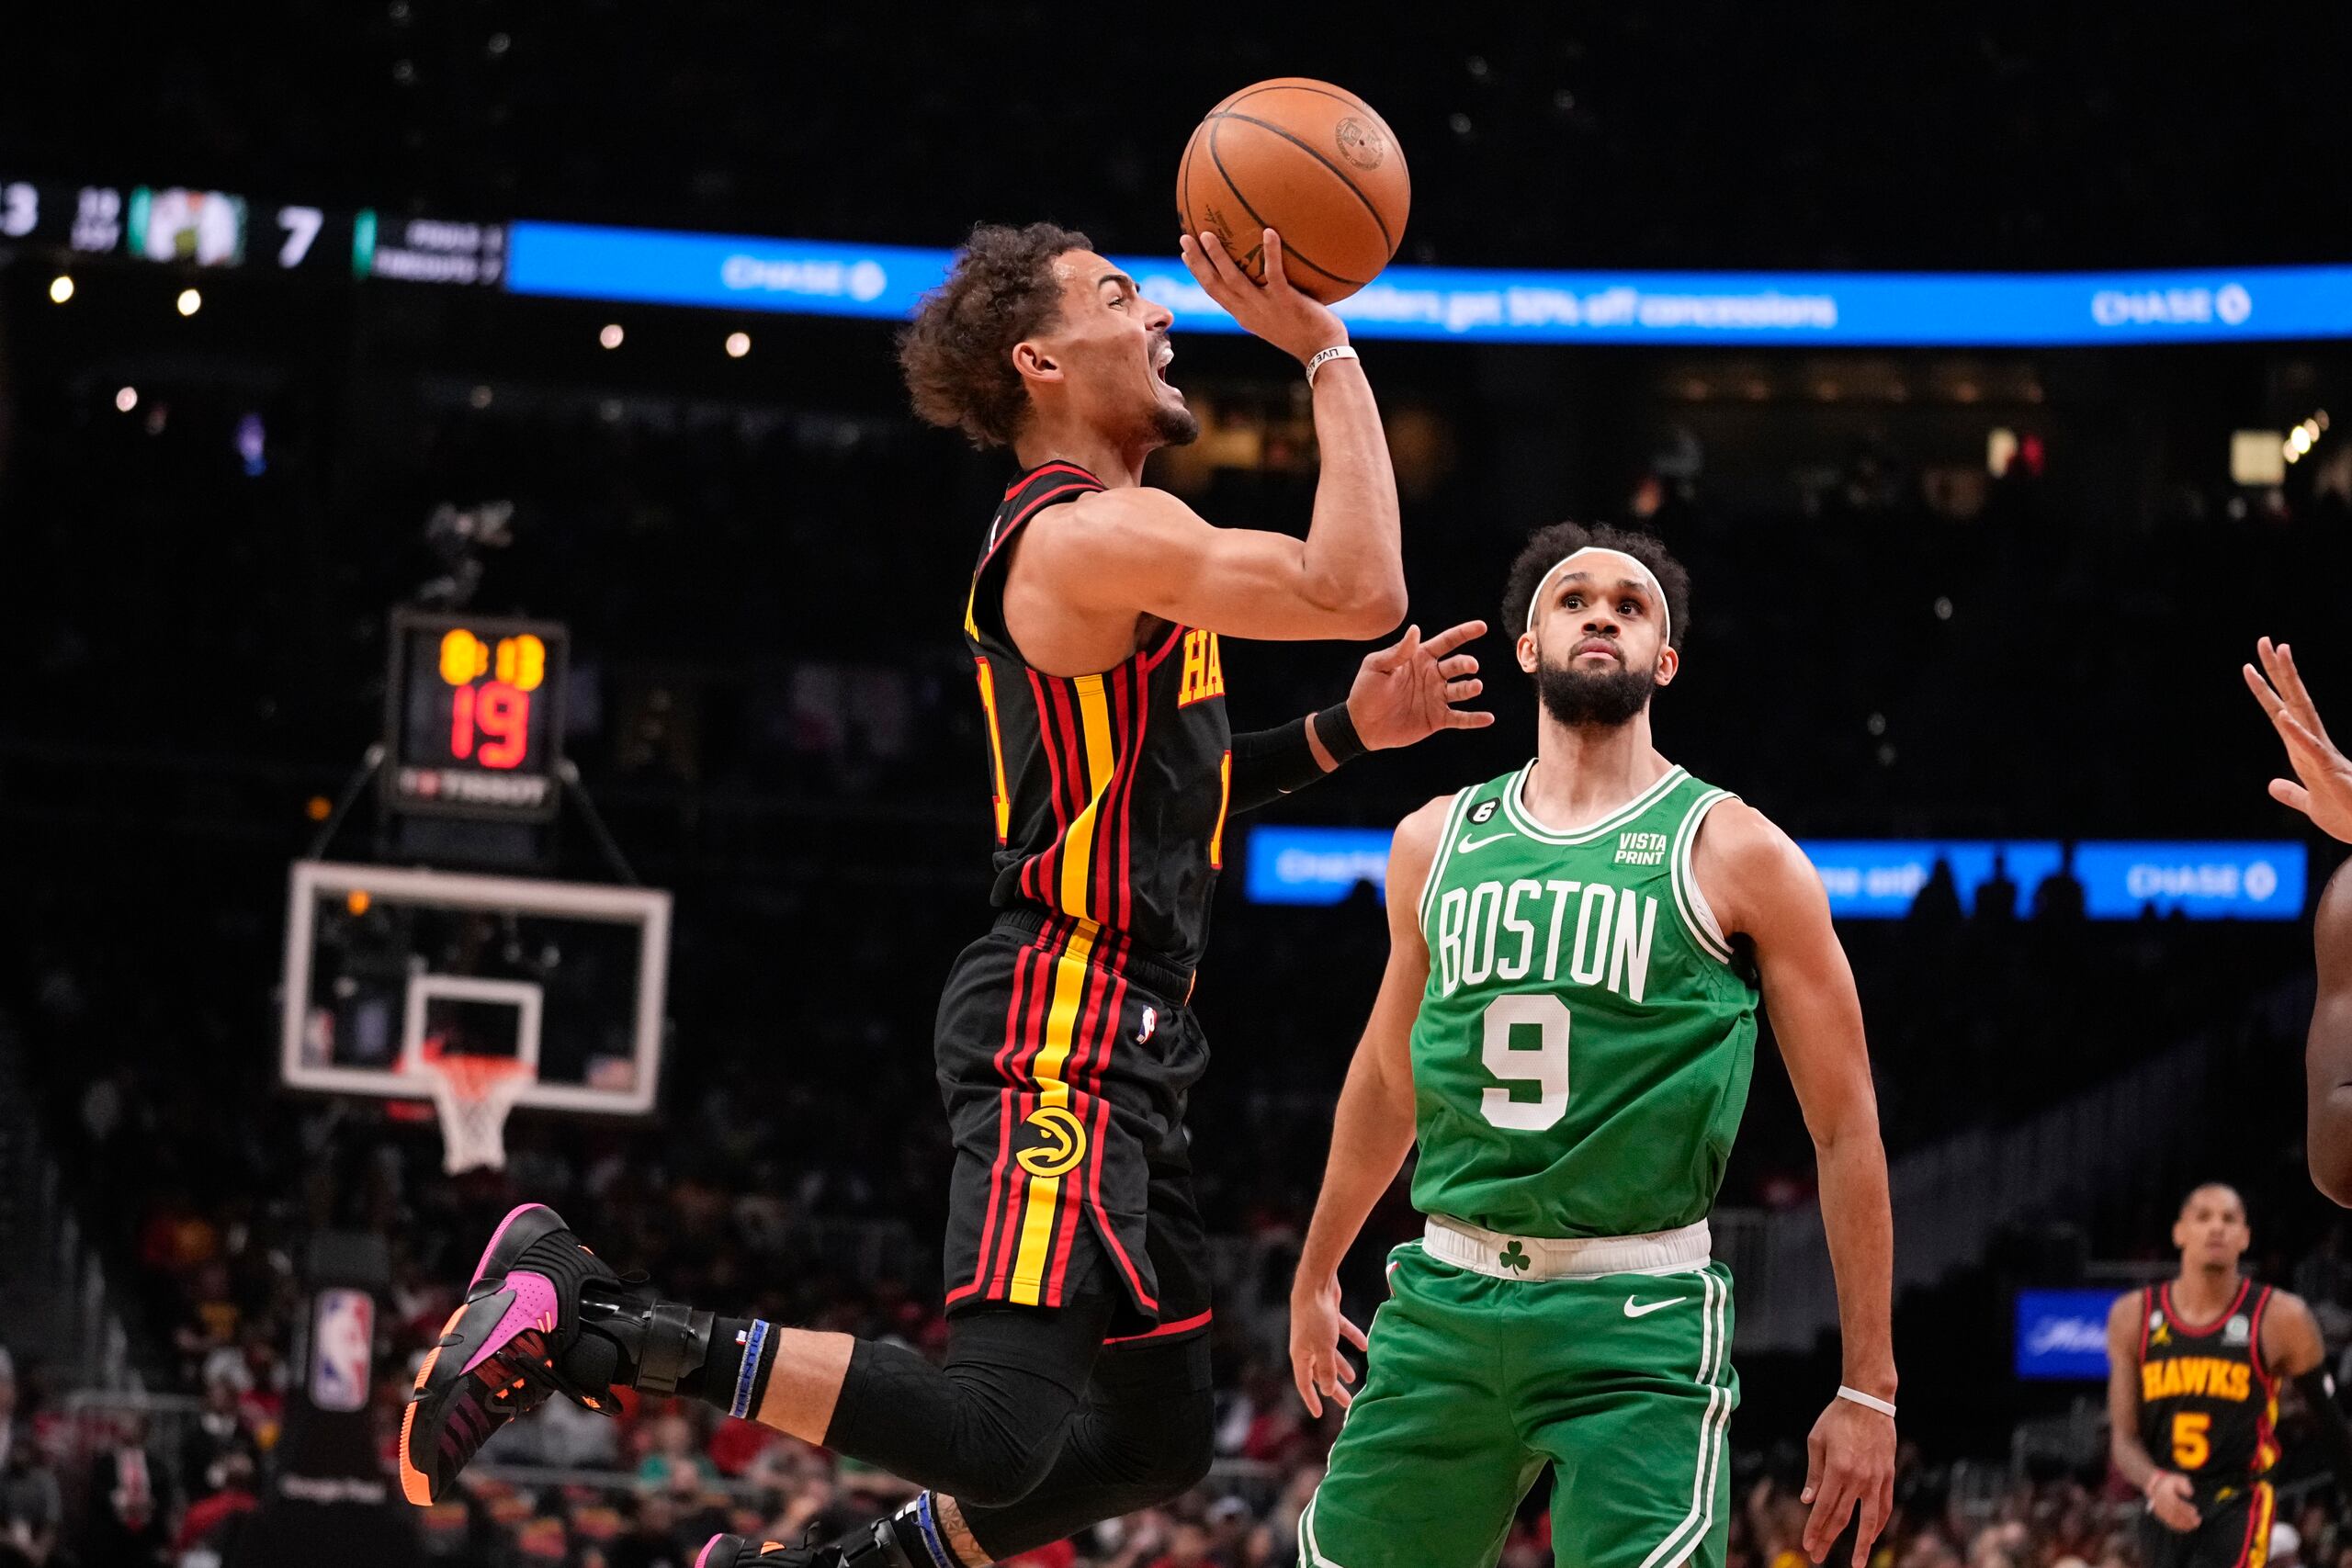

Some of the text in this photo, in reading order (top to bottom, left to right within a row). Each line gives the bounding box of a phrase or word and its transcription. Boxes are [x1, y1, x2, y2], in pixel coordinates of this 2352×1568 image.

[0, 182, 39, 236] 3
[277, 206, 323, 268] 7
[720, 254, 842, 296] CHASE
[2092, 289, 2211, 326] CHASE
[1316, 348, 1340, 363] LIVE
[451, 681, 530, 770] 19
[1473, 801, 1496, 822] 6
[1614, 850, 1665, 865] PRINT
[1620, 832, 1668, 852] VISTA
[2127, 864, 2239, 898] CHASE
[1439, 879, 1658, 1004] BOSTON
[1480, 994, 1571, 1131] 9
[2143, 1357, 2251, 1403] HAWKS
[2172, 1412, 2211, 1470] 5
